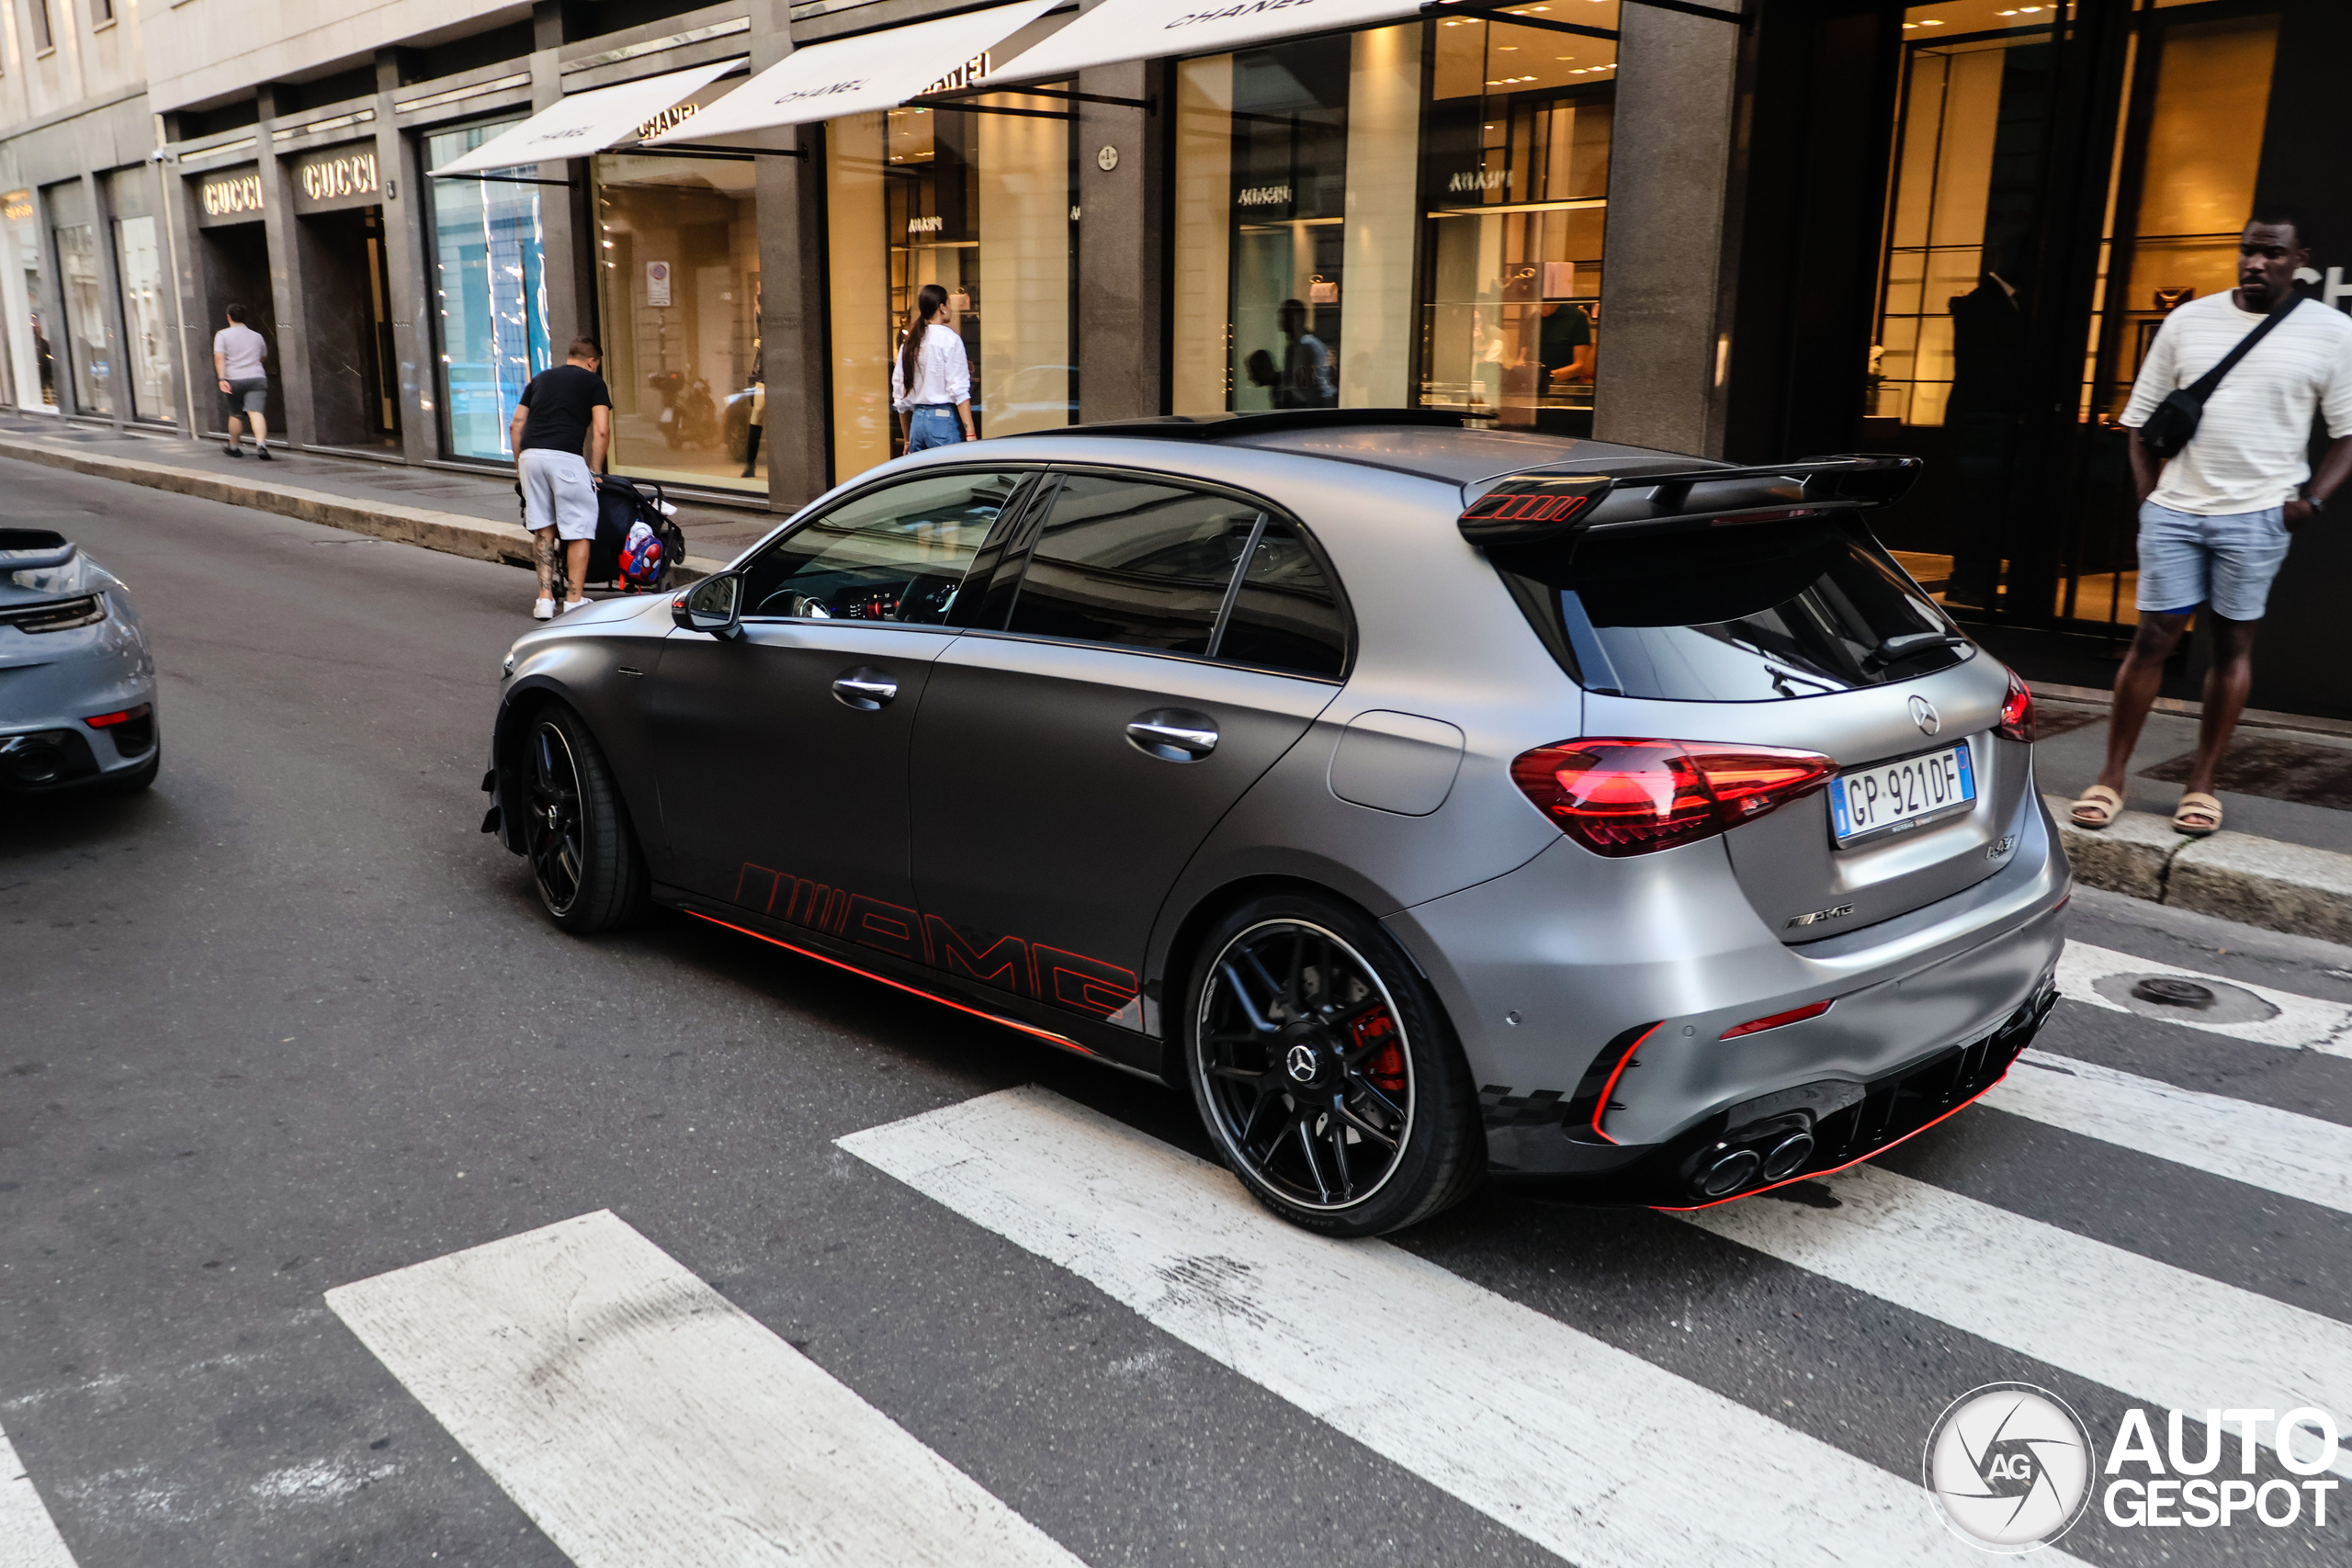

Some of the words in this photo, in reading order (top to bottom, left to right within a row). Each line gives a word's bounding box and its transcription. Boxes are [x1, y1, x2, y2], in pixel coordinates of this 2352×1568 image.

[774, 78, 871, 105] CHANEL
[202, 175, 264, 216] GUCCI
[303, 153, 379, 199] GUCCI
[1849, 775, 1878, 826] GP
[1888, 754, 1956, 815] 921DF
[837, 893, 1144, 1023] AMG
